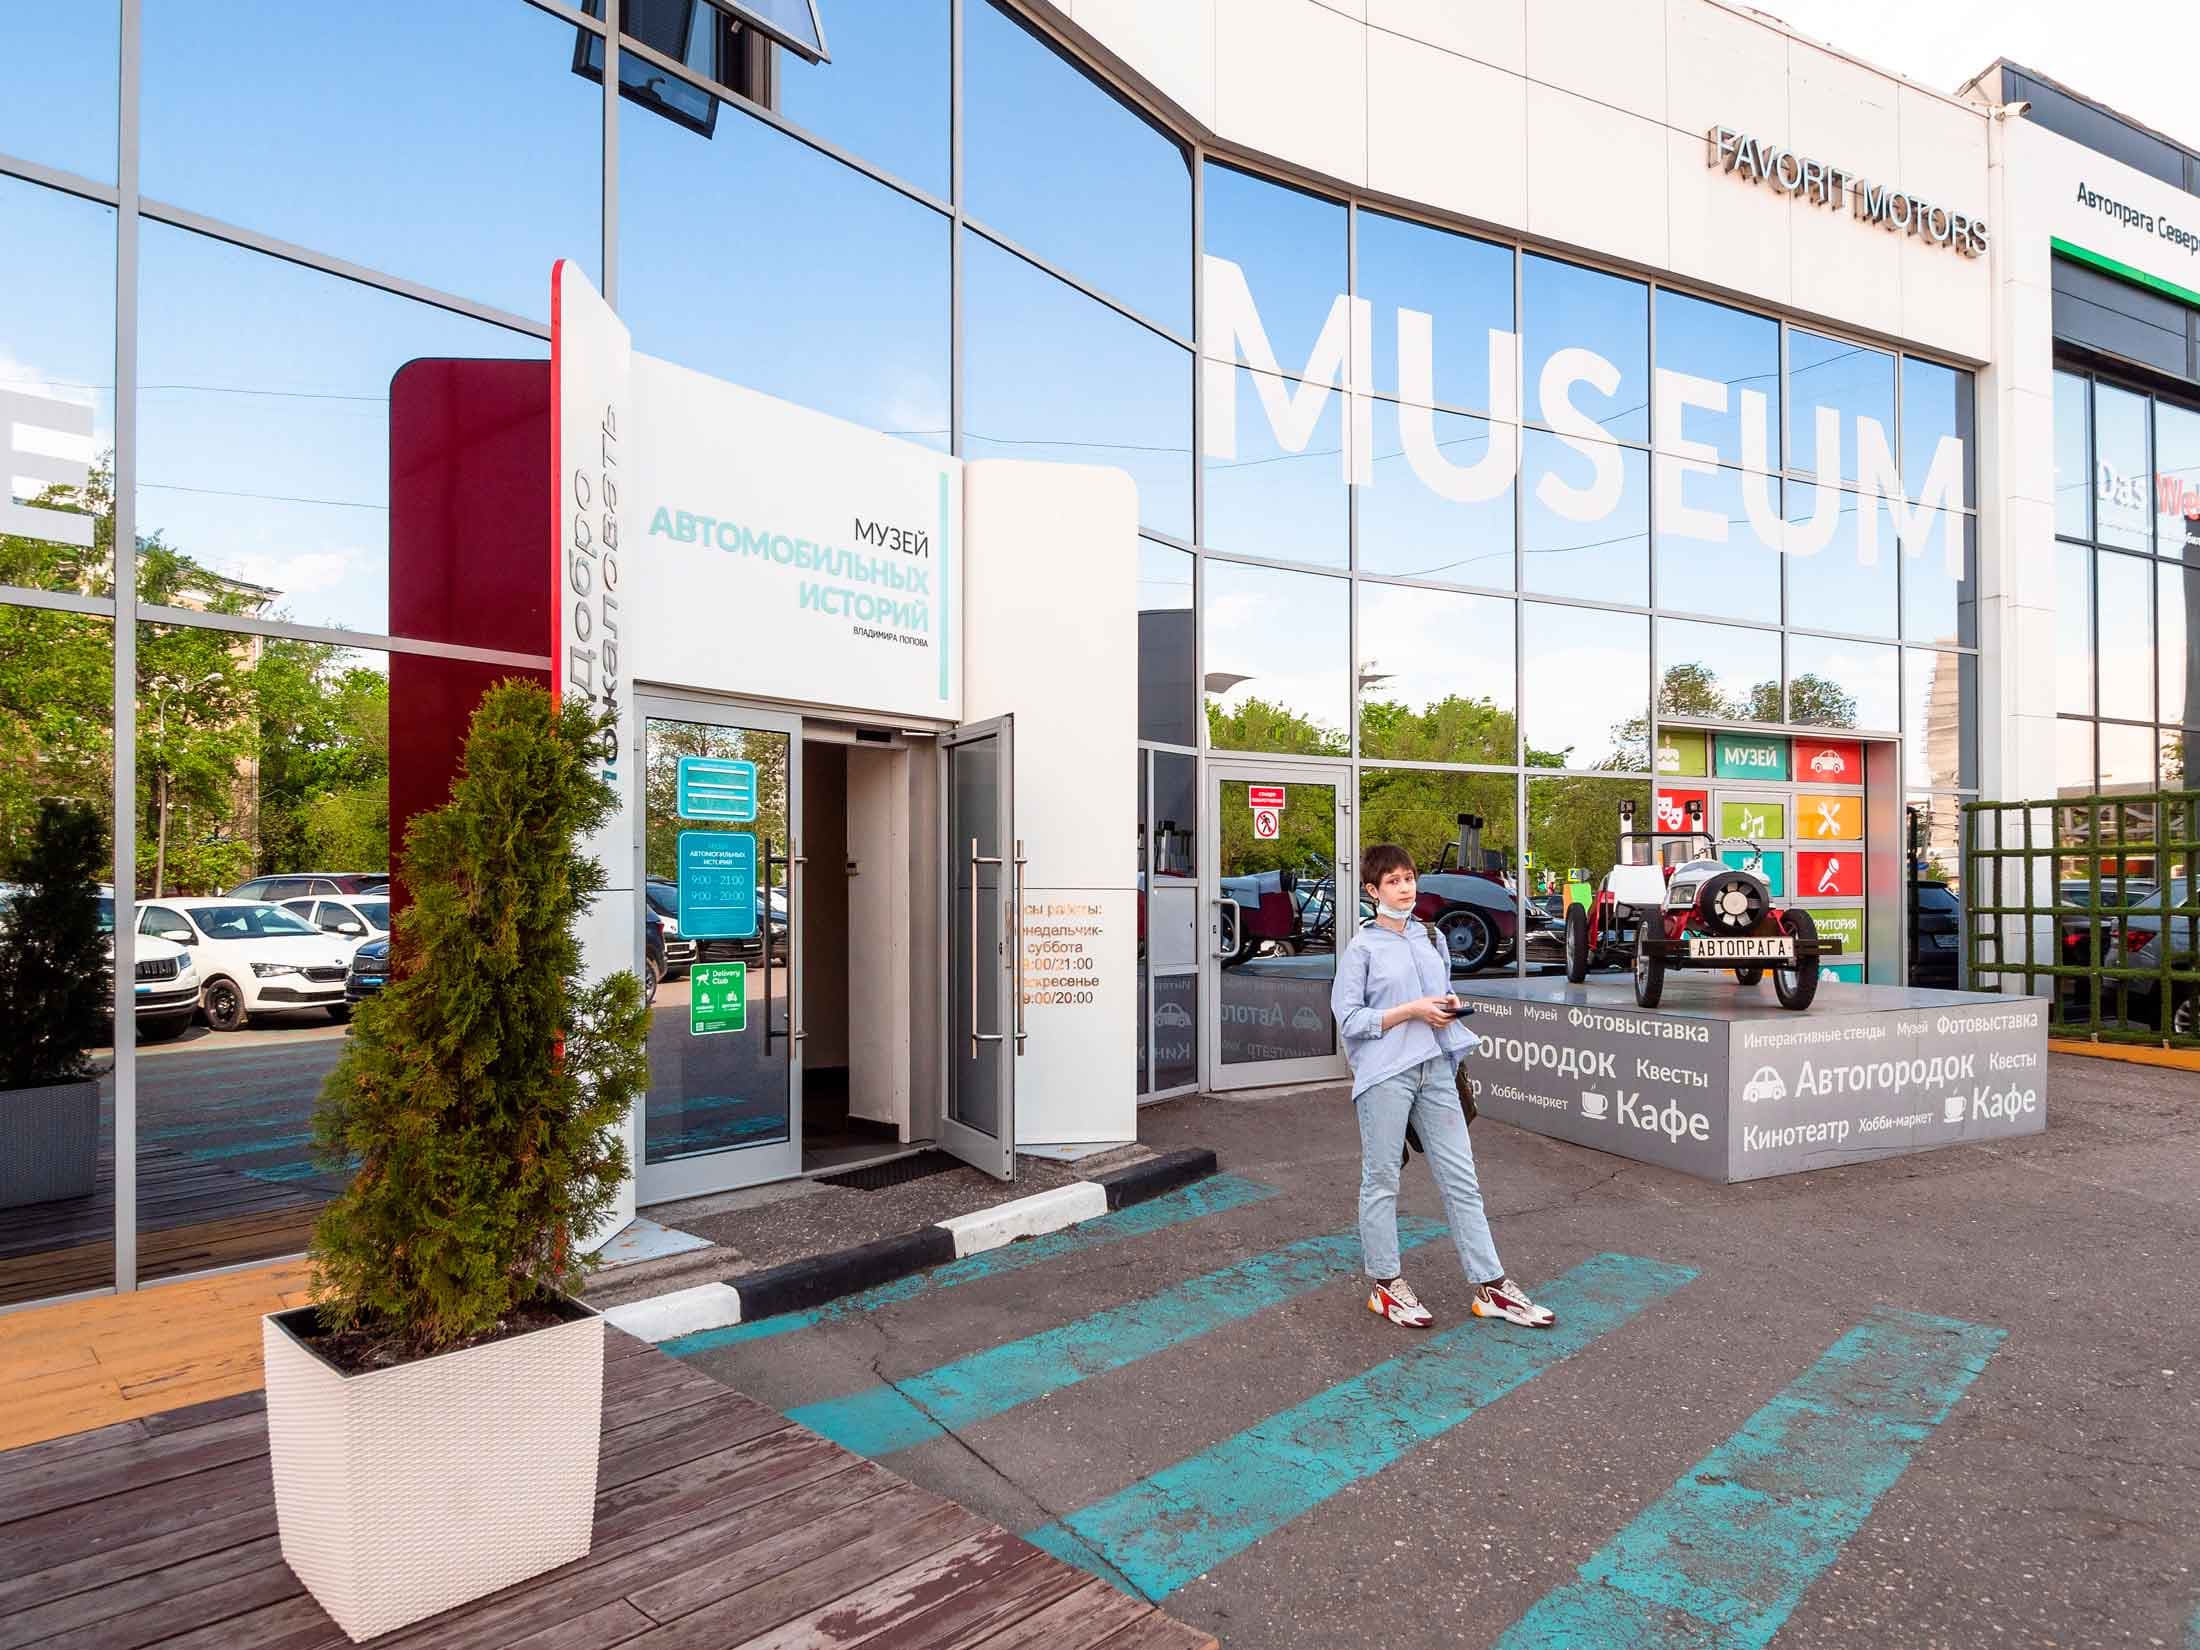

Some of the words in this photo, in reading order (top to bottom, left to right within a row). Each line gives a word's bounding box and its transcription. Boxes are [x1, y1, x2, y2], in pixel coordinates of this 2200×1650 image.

[1711, 126, 1853, 211] FAVORIT
[1861, 177, 1988, 256] MOTORS
[2077, 182, 2154, 233] Автопрага
[2158, 216, 2200, 256] Север
[1202, 253, 1965, 581] MUSEUM
[649, 506, 928, 595] АВТОМОБИЛЬНЫХ
[855, 517, 928, 559] МУЗЕЙ
[569, 468, 598, 703] Добро
[799, 581, 929, 633] ИСТОРИЙ
[853, 626, 898, 642] ВЛАДИМИРА
[899, 634, 929, 647] ПОПОВА
[1724, 745, 1777, 767] МУЗЕЙ
[1027, 940, 1084, 956] суббота
[1698, 940, 1786, 956] АВТОПРАГА
[1813, 919, 1857, 931] РРИТОРИЯ
[712, 970, 741, 978] Delivery
[1472, 1002, 1512, 1017] стенды
[1523, 1004, 1558, 1022] Музей
[1568, 1007, 1710, 1043] Фотовыставка
[1744, 1029, 1841, 1049] Интерактивные
[1843, 1025, 1886, 1041] стенды
[1897, 1020, 1929, 1038] Музей
[1937, 1012, 2039, 1035] Фотовыставка
[1476, 1034, 1617, 1080] огородок
[1637, 1058, 1709, 1088] Квесты
[1795, 1053, 1976, 1098] Автогородок
[1989, 1051, 2038, 1071] Квесты
[1491, 1083, 1569, 1112] Хобби-маркет
[1617, 1090, 1711, 1144] Кафе
[1743, 1118, 1850, 1152] Кинотеатр
[1858, 1111, 1935, 1133] Хобби-маркет
[1972, 1082, 2037, 1123] Кафе
